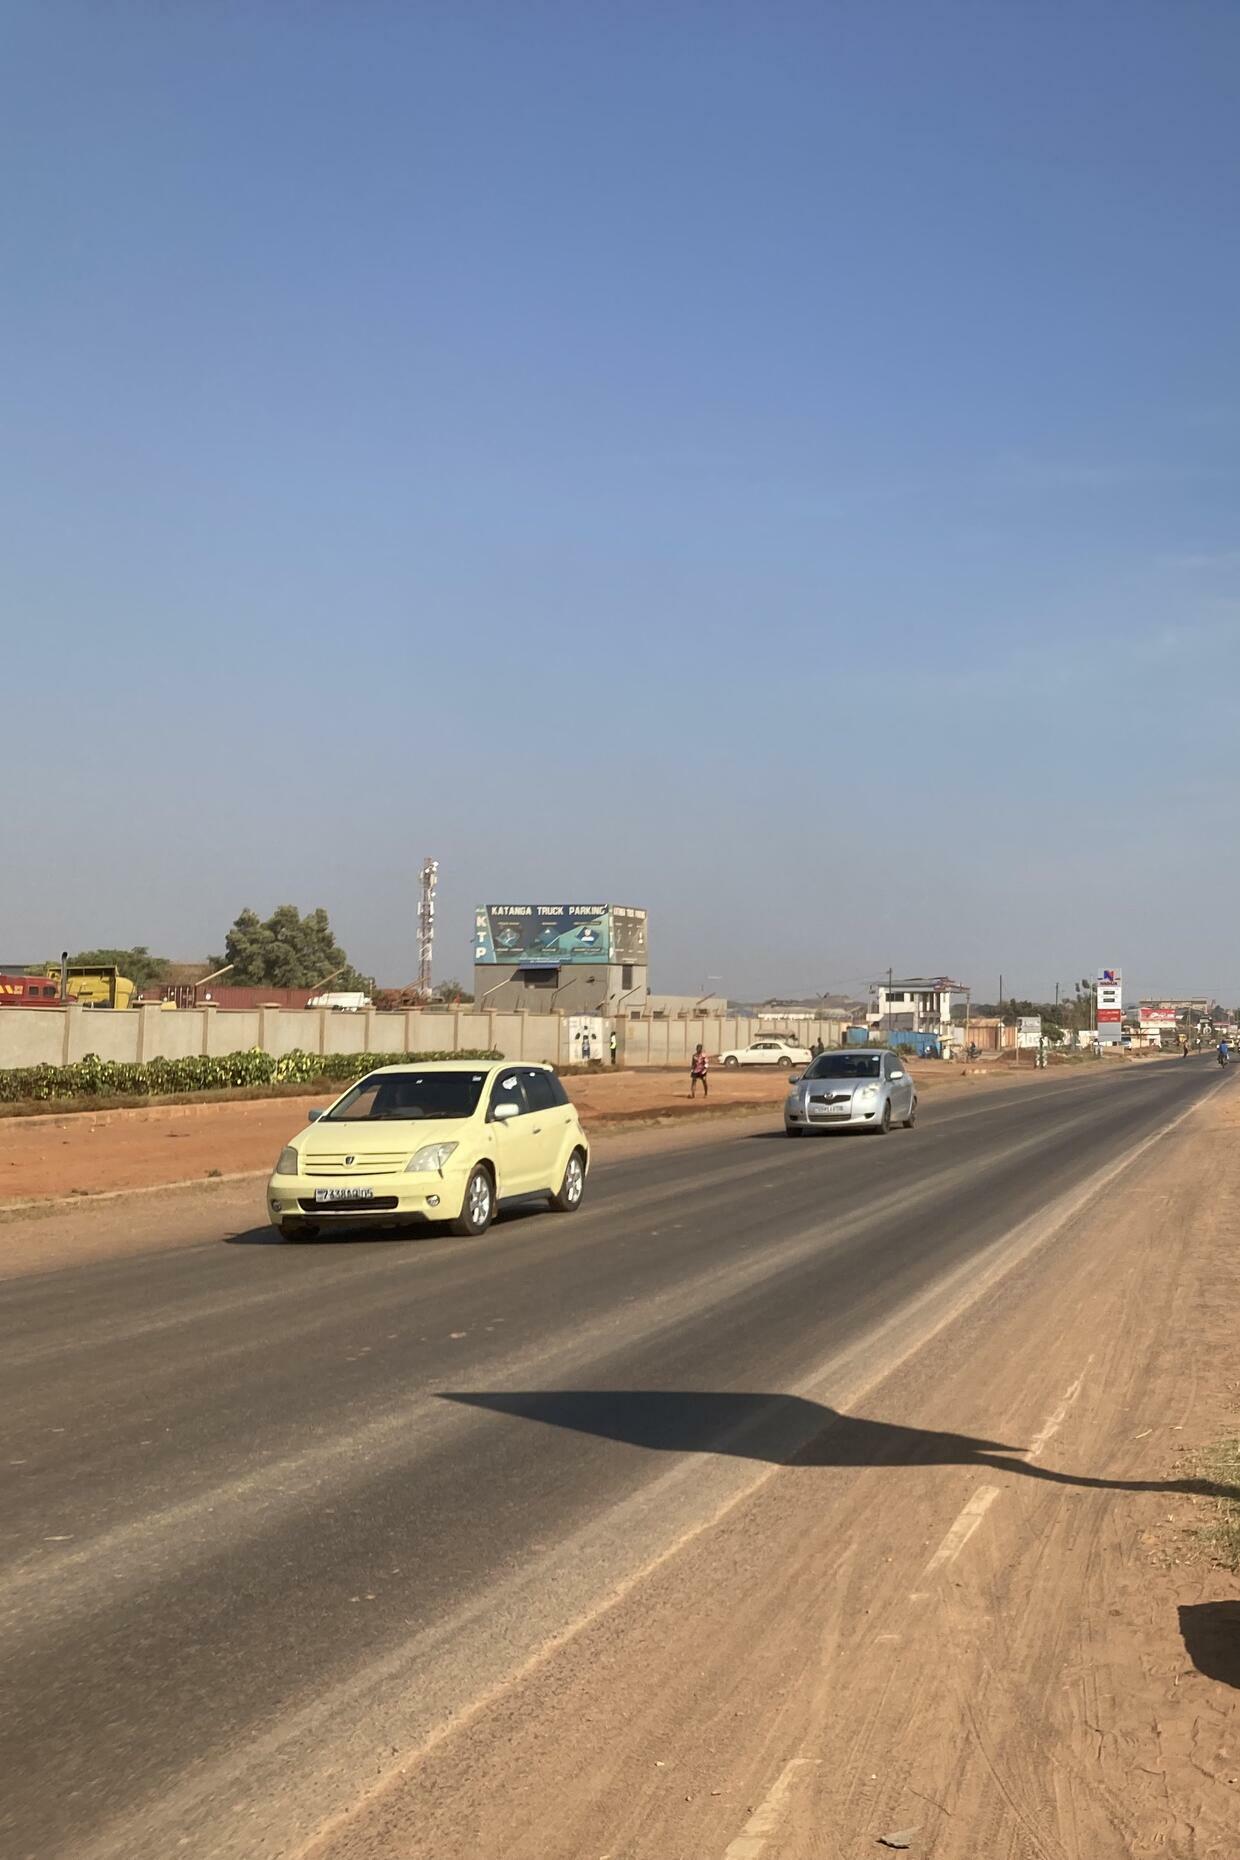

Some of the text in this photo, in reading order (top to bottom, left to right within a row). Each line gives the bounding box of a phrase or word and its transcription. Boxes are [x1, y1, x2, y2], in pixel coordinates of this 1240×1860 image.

[491, 906, 532, 916] KATANGA
[536, 906, 564, 916] TRUCK
[568, 904, 607, 916] PARKING
